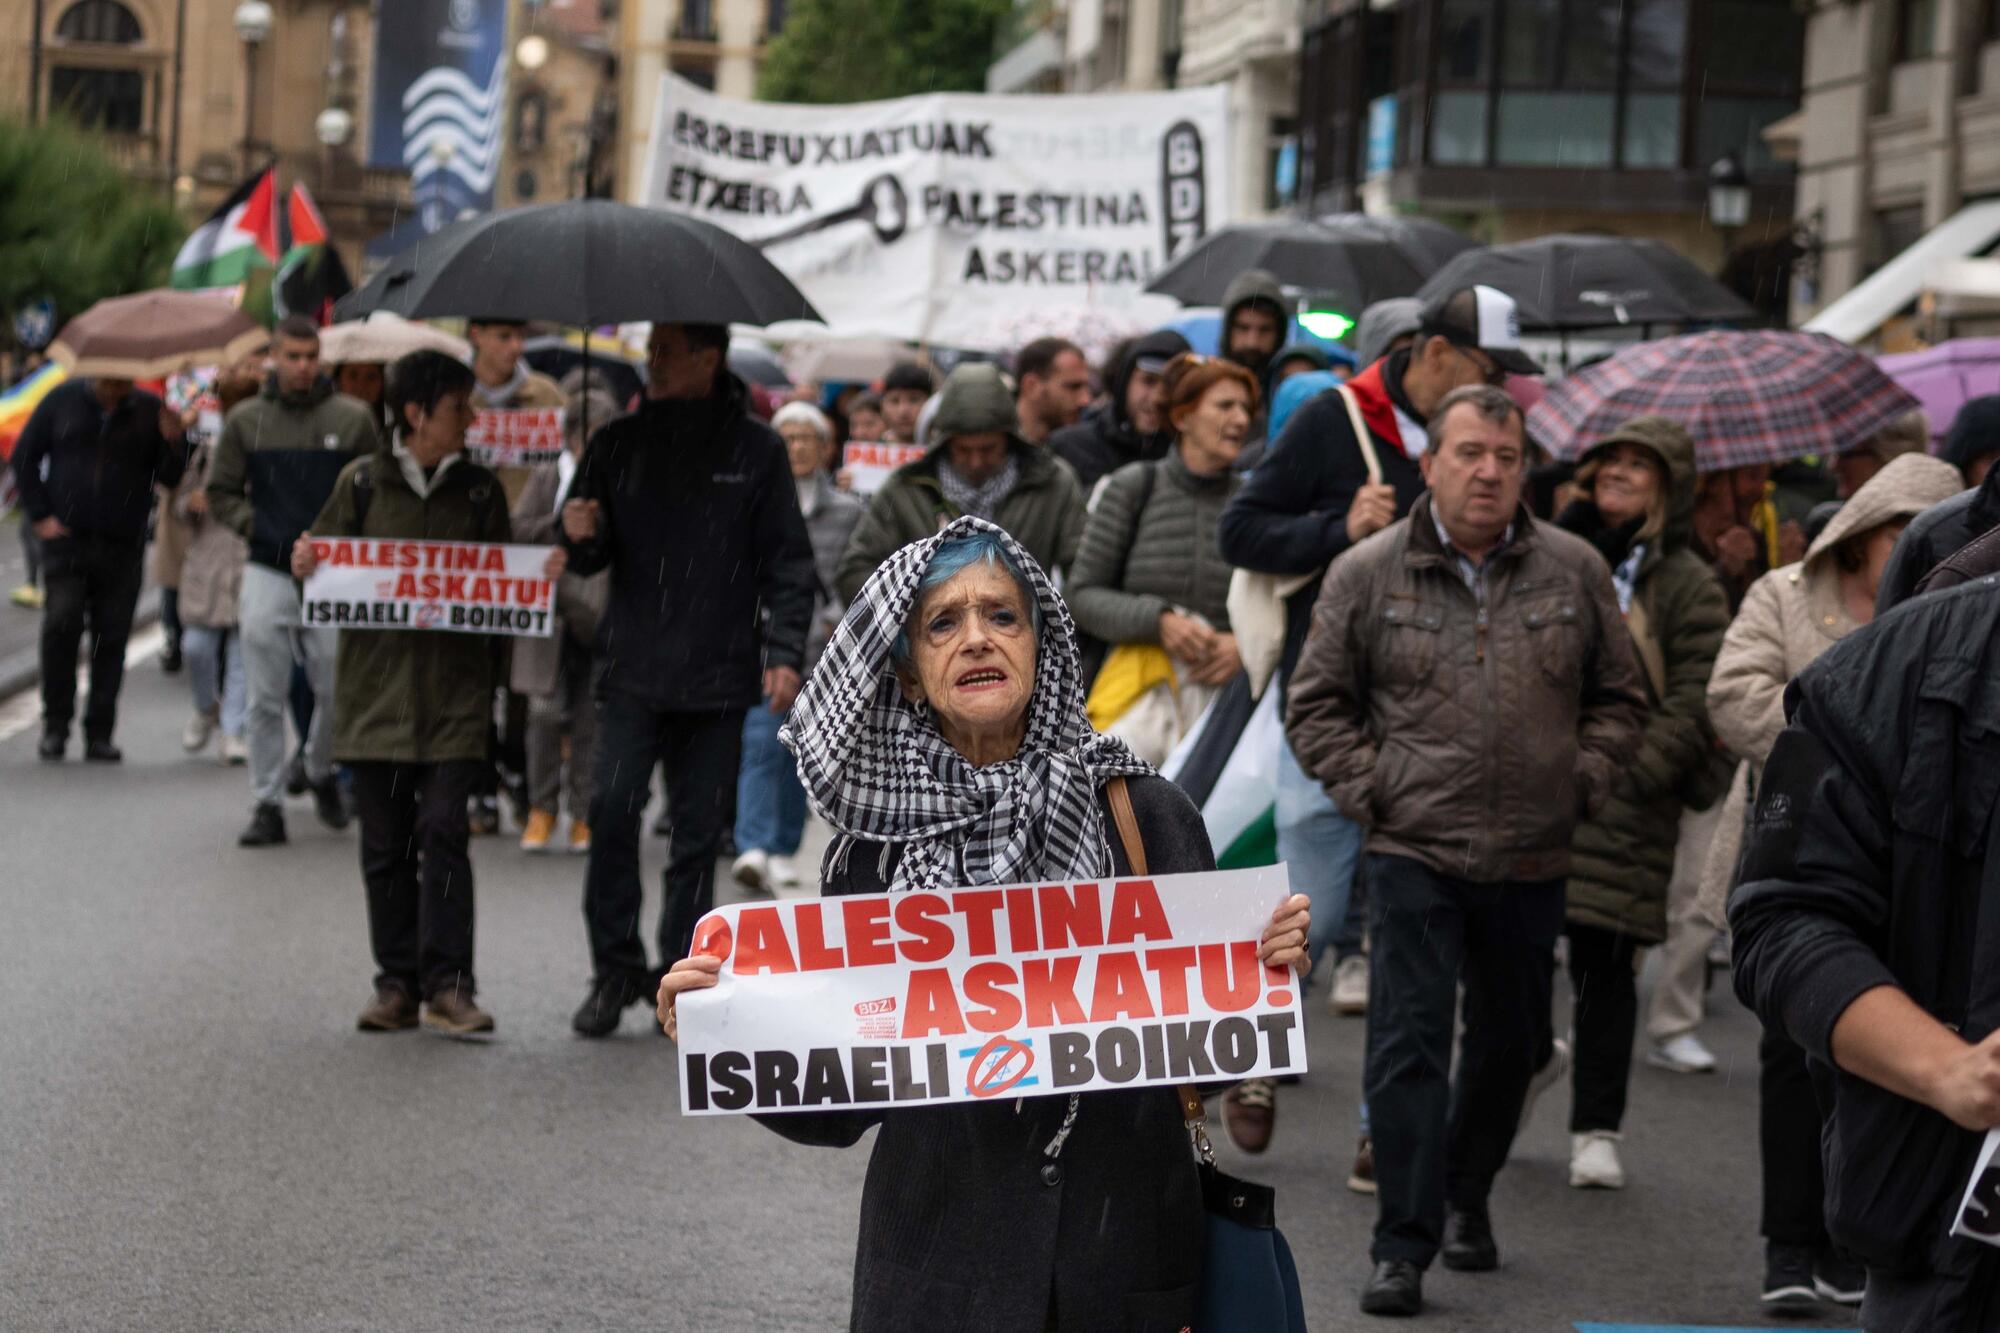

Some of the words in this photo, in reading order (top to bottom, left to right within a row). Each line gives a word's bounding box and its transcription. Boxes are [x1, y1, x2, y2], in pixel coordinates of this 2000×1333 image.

[673, 110, 992, 165] ERREFUXIATUAK
[666, 165, 812, 215] ETXERA
[923, 185, 1147, 229] PALESTINA
[311, 541, 505, 572] PALESTINA
[307, 601, 409, 624] ISRAELI
[450, 606, 548, 630] BOIKOT
[394, 573, 554, 608] ASKATU!
[690, 880, 1173, 975] PALESTINA
[901, 940, 1294, 1039] ASKATU!
[686, 1043, 950, 1111] ISRAELI
[1049, 1011, 1297, 1089] BOIKOT
